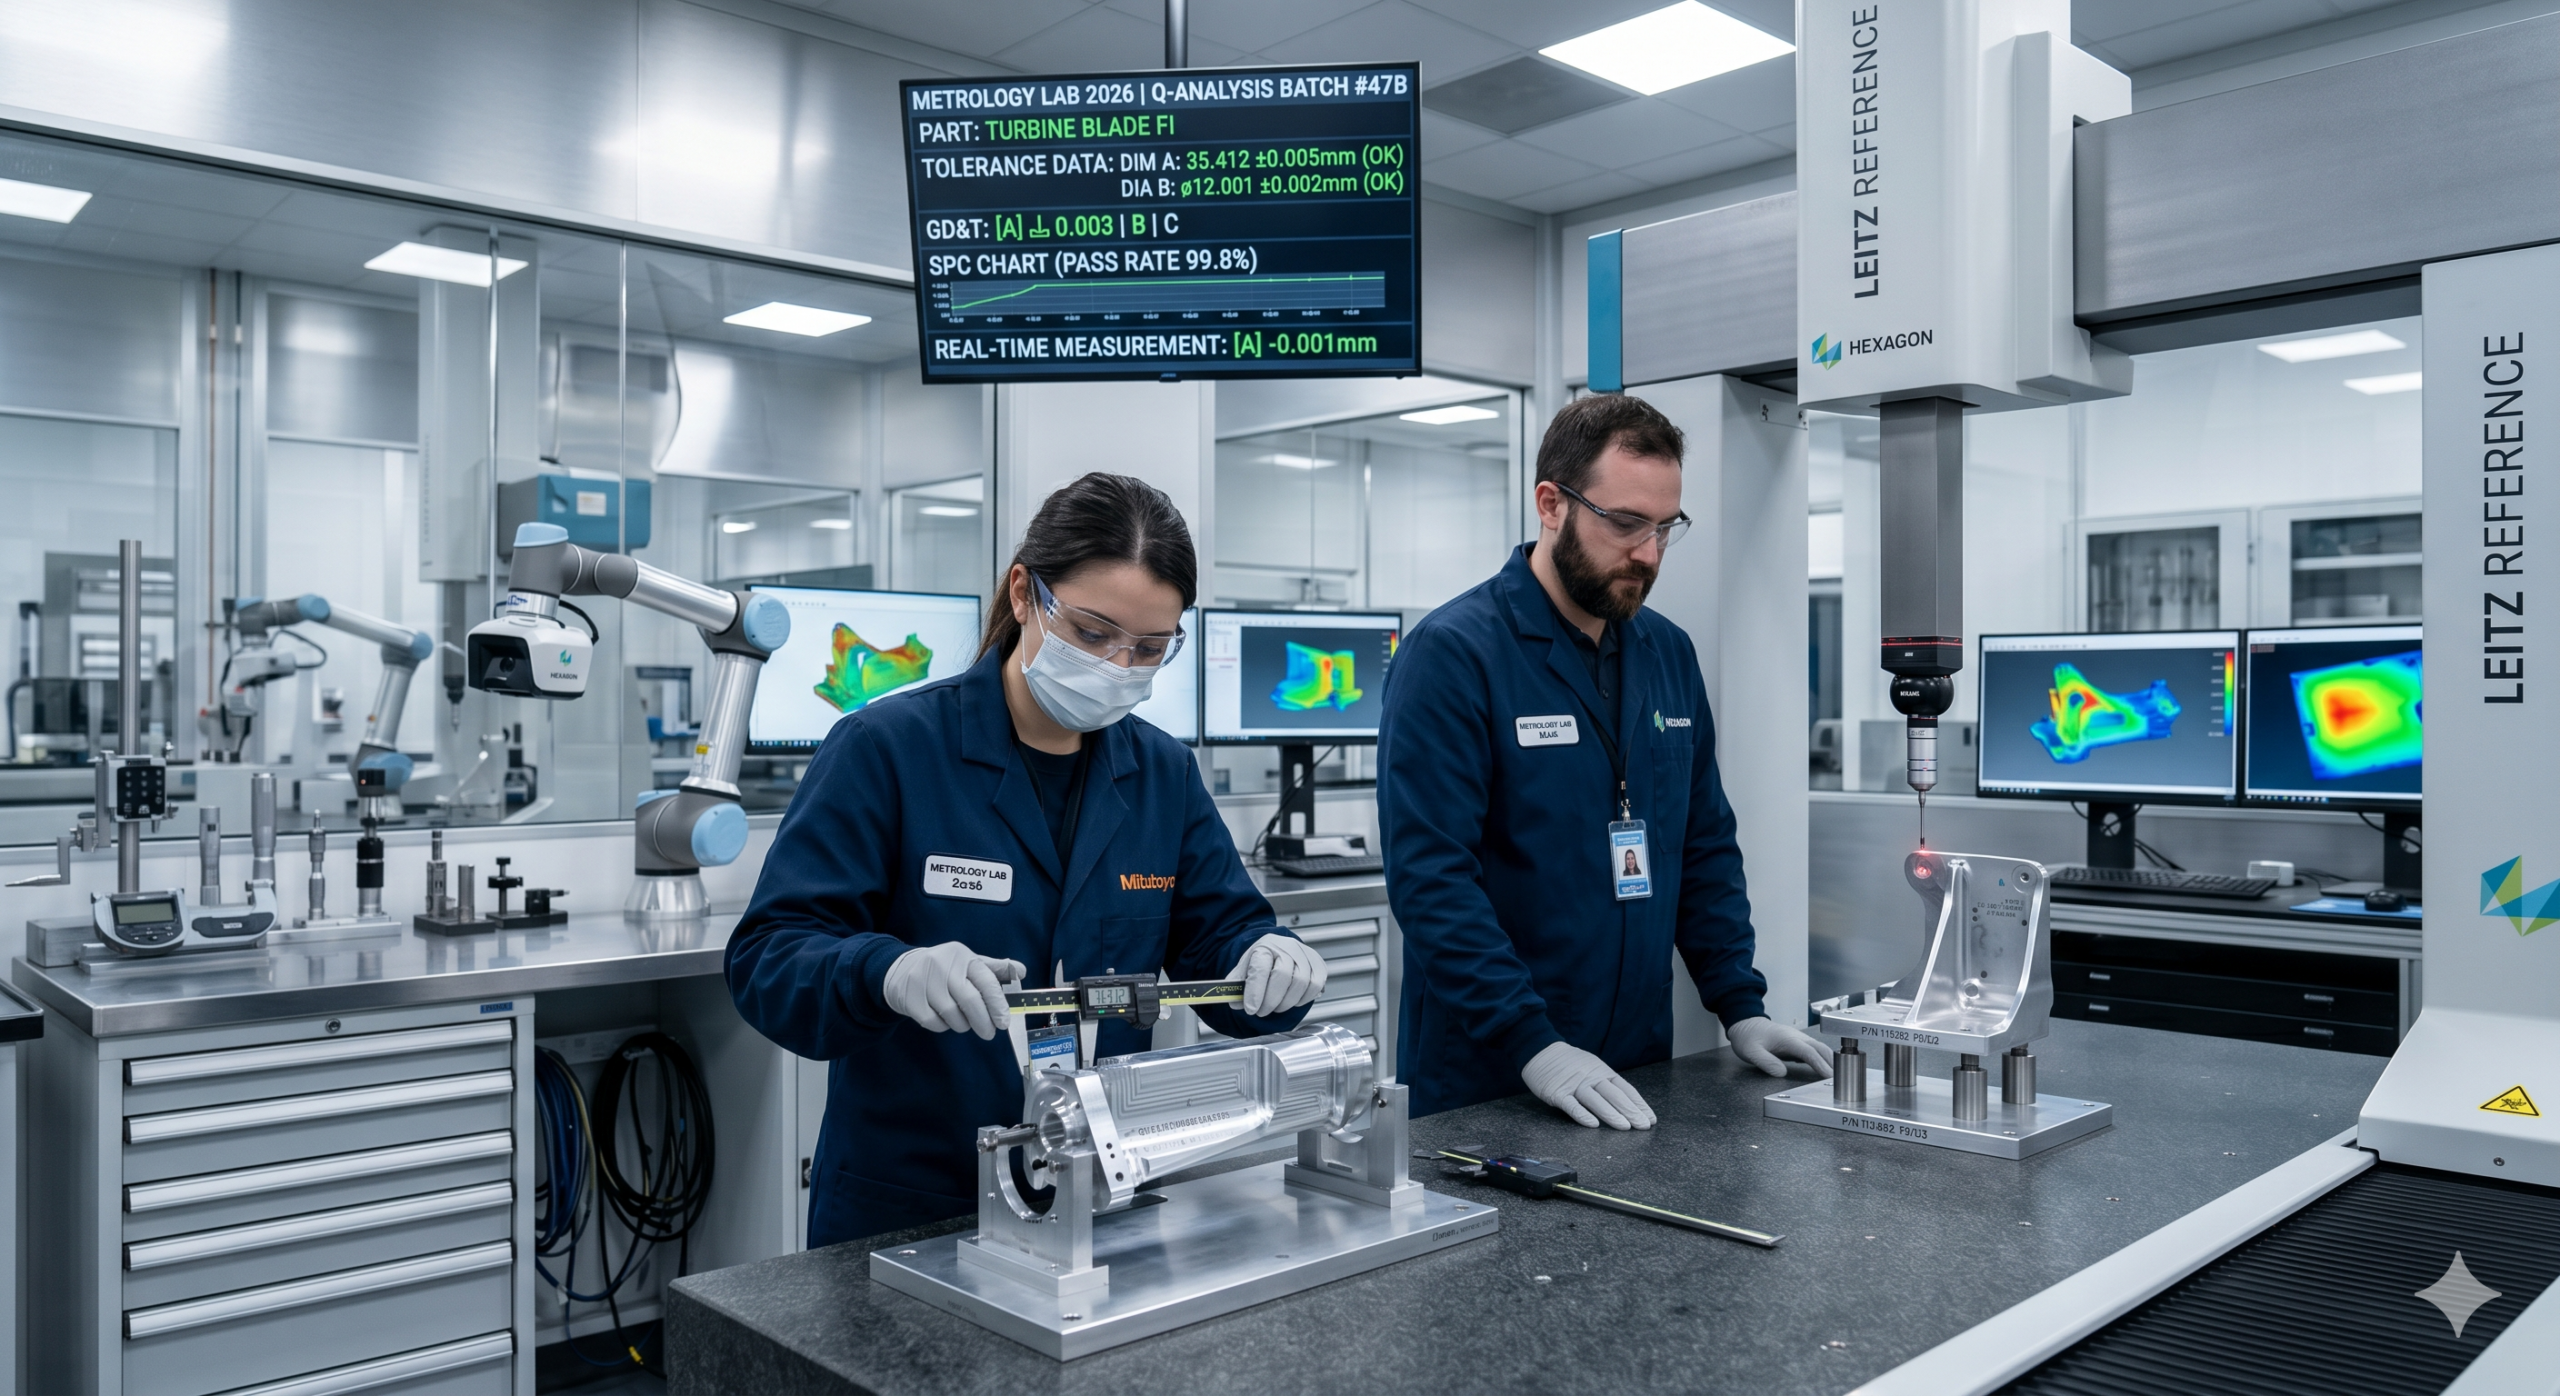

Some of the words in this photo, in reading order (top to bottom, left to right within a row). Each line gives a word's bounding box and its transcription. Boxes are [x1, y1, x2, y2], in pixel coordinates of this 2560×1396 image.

[912, 87, 1035, 110] METROLOGY
[1041, 85, 1080, 106] LAB
[1085, 84, 1135, 104] 2026
[1152, 79, 1274, 104] Q-ANALYSIS
[1280, 77, 1349, 98] BATCH
[1354, 74, 1408, 96] #47B
[1852, 4, 1879, 197] REFERENCE
[919, 121, 980, 143] PART:
[985, 118, 1076, 141] TURBINE
[1082, 116, 1151, 138] BLADE
[1156, 115, 1174, 136] FI
[921, 155, 1047, 178] TOLERANCE
[1053, 153, 1114, 175] DATA:
[1120, 152, 1156, 172] DIM
[1162, 152, 1181, 171] A:
[1186, 150, 1250, 170] 35.412
[1255, 148, 1356, 169] ±0.005mm
[1362, 143, 1404, 170] (OK)
[1121, 179, 1153, 198] DIA
[1158, 178, 1176, 197] B:
[1260, 174, 1357, 195] ±0.002mm
[1364, 170, 1404, 196] (OK)
[926, 218, 990, 240] GD&T:
[995, 214, 1023, 241] [A]
[1055, 215, 1114, 238] 0.003
[1132, 214, 1146, 235] B
[1163, 213, 1179, 234] C
[929, 254, 971, 276] SPC
[976, 252, 1049, 275] CHART
[1055, 250, 1118, 279] (PASS
[1124, 250, 1180, 272] RATE
[1186, 246, 1257, 275] 99.8%)
[1853, 206, 1879, 299] LEITZ
[935, 337, 1049, 360] REAL-TIME
[1055, 334, 1227, 358] MEASUREMENT:
[1234, 331, 1262, 358] [A]
[1269, 332, 1377, 355] -0.001mm
[1849, 329, 1933, 356] HEXAGON
[2483, 332, 2524, 575] REFERENCE
[2484, 591, 2524, 703] LEITZ
[930, 863, 987, 878] METROLOGY
[989, 870, 1007, 880] LAB
[1861, 1026, 1878, 1037] P/N
[1842, 1116, 1859, 1127] P/N
